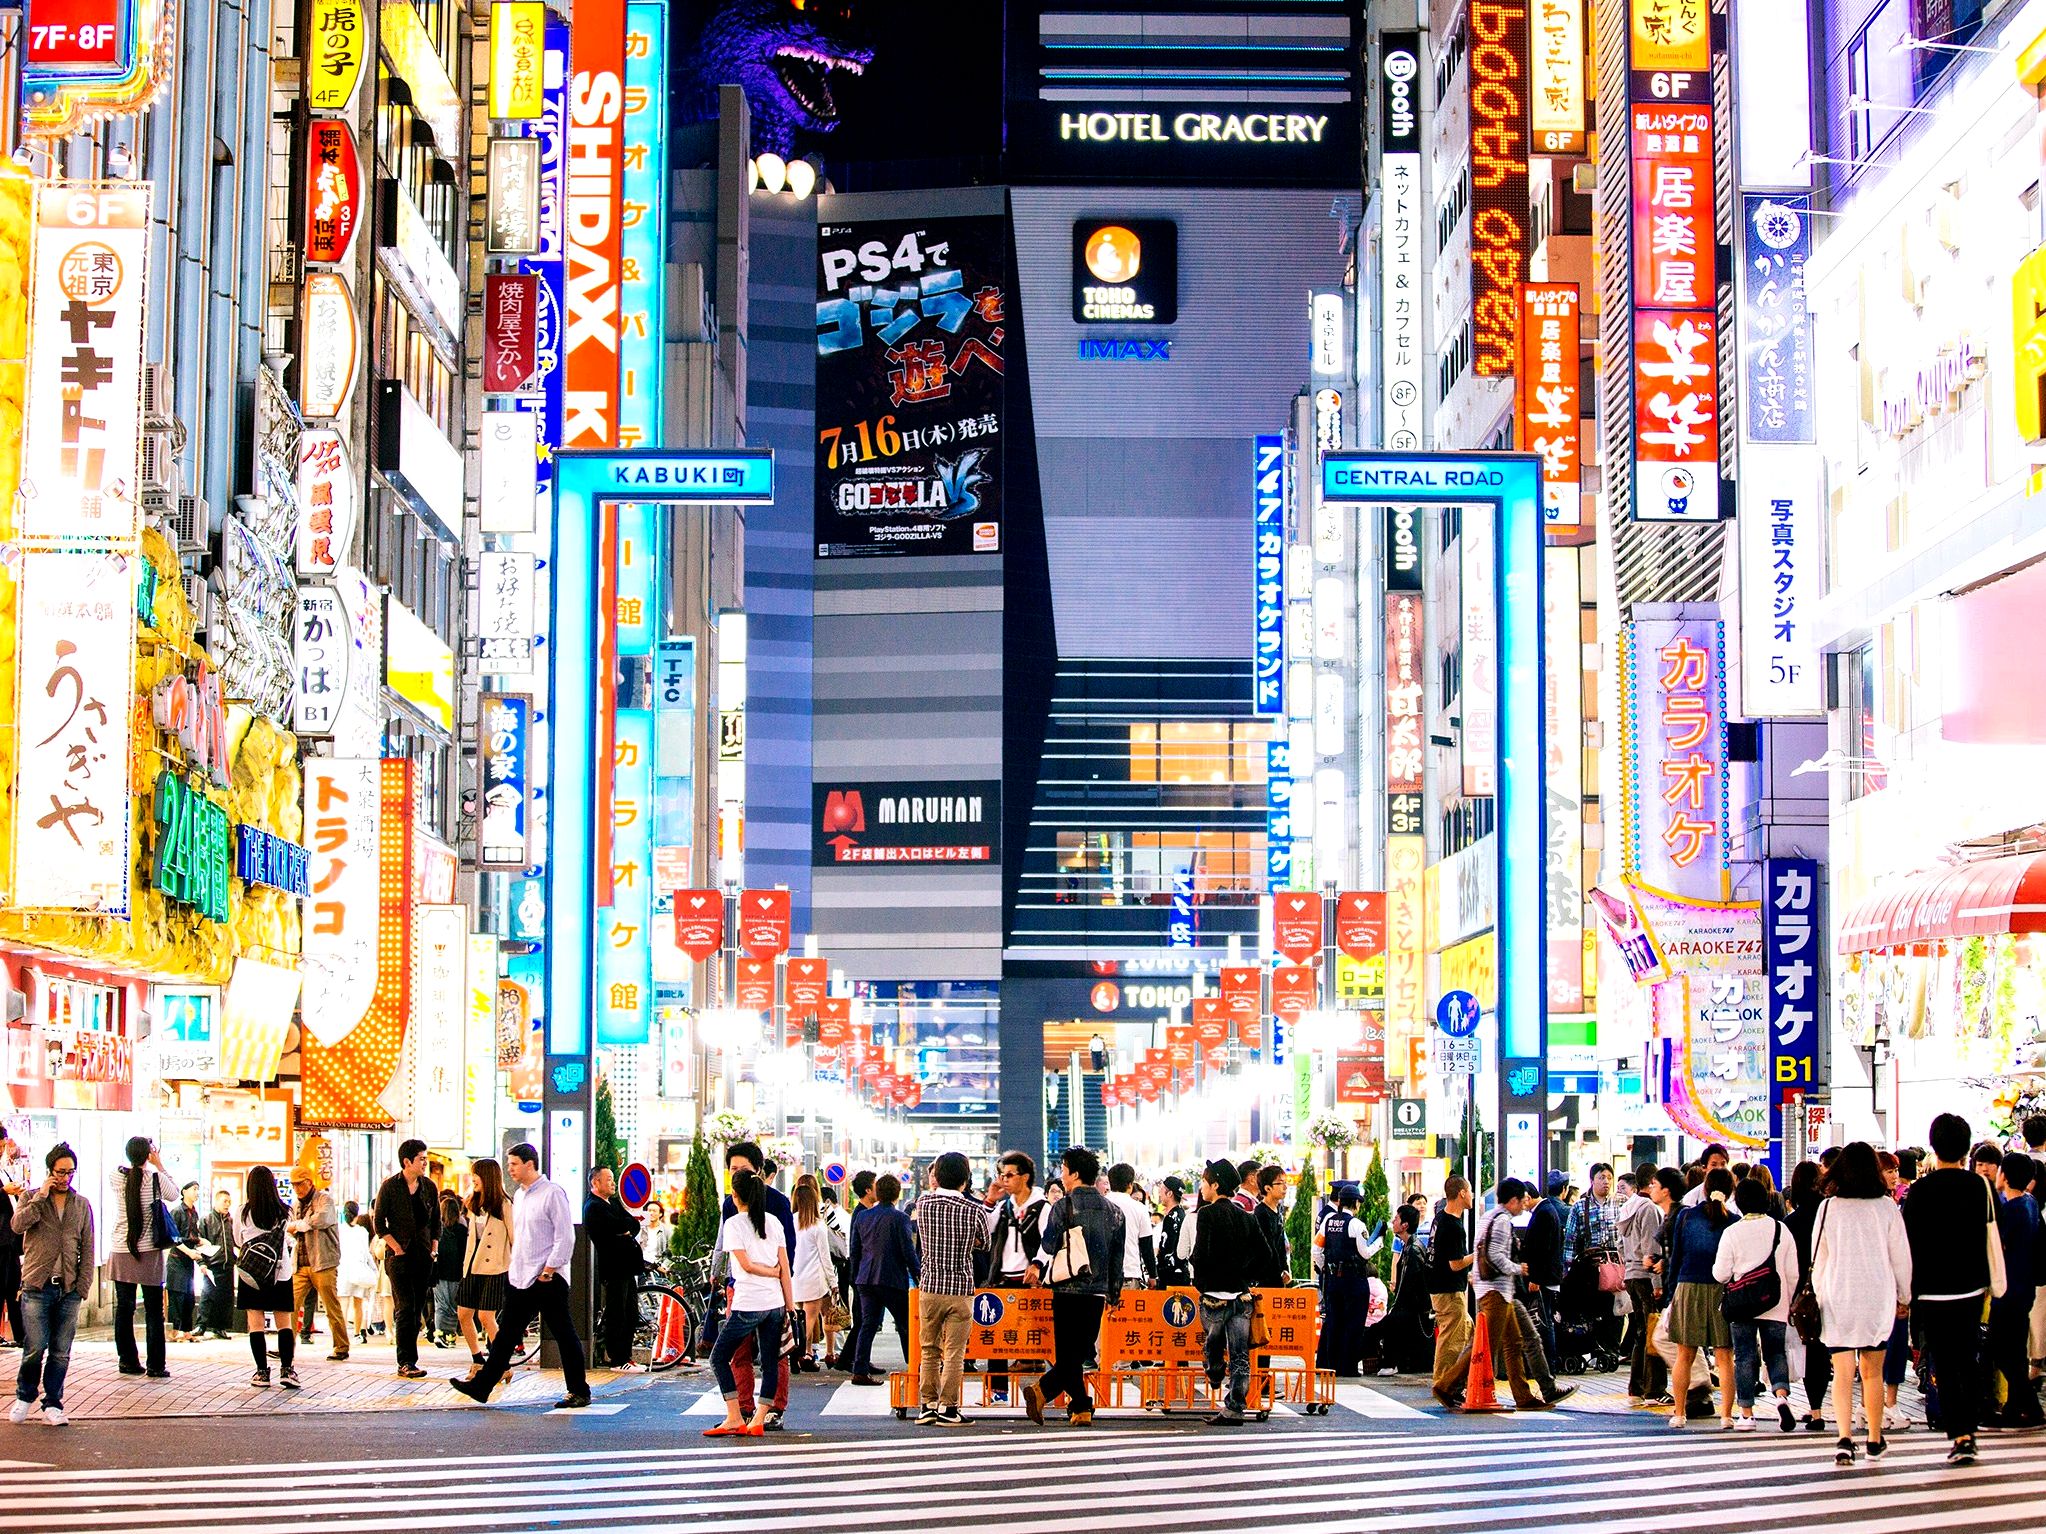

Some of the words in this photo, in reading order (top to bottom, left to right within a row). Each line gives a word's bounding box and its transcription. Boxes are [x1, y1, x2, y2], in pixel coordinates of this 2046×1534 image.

[320, 8, 355, 76] 虎の子
[316, 90, 339, 102] 4F
[1651, 73, 1691, 98] 6F
[1061, 113, 1169, 141] HOTEL
[1174, 113, 1329, 141] GRACERY
[1636, 114, 1708, 131] 新しいタイプの
[1545, 132, 1573, 149] 6F
[67, 193, 124, 225] 6F
[569, 71, 625, 355] SHIDAX
[1651, 167, 1696, 302] 居楽屋
[68, 252, 89, 296] 元祖
[91, 253, 114, 295] 東京
[1083, 287, 1136, 304] TOHO
[1083, 304, 1155, 319] CINEMAS
[497, 282, 524, 381] 焼肉屋さかい
[1322, 310, 1336, 365] 東京ビル
[1078, 340, 1170, 361] IMAX
[885, 331, 1005, 408] 遊べ
[519, 382, 533, 391] 4F
[1396, 387, 1412, 400] 8F
[1396, 436, 1412, 448] 5F
[1257, 447, 1281, 523] 747
[1335, 471, 1437, 485] CENTRAL
[1445, 472, 1504, 486] ROAD
[1391, 506, 1418, 570] ooth
[1771, 500, 1796, 642] 写真スタジオ
[303, 599, 333, 611] 新宿
[1258, 531, 1281, 705] カラオケランド
[1769, 656, 1802, 683] 5F
[305, 706, 328, 721] B1
[490, 704, 518, 780] 海の家
[1660, 637, 1716, 867] カラオケ
[878, 796, 982, 823] MARUHAN
[1392, 795, 1421, 812] 4F
[1392, 814, 1421, 832] 3F
[310, 776, 349, 936] トラノコ
[610, 741, 639, 1011] カラオケ館
[1774, 869, 1813, 1046] カラオケ
[1124, 984, 1191, 1008] TOHO
[1711, 975, 1748, 1119] カラオケ
[1775, 1056, 1812, 1083] B1
[1807, 1107, 1826, 1142] 探偵
[1272, 1297, 1307, 1309] 日祭日
[967, 1330, 1042, 1346] 者専用
